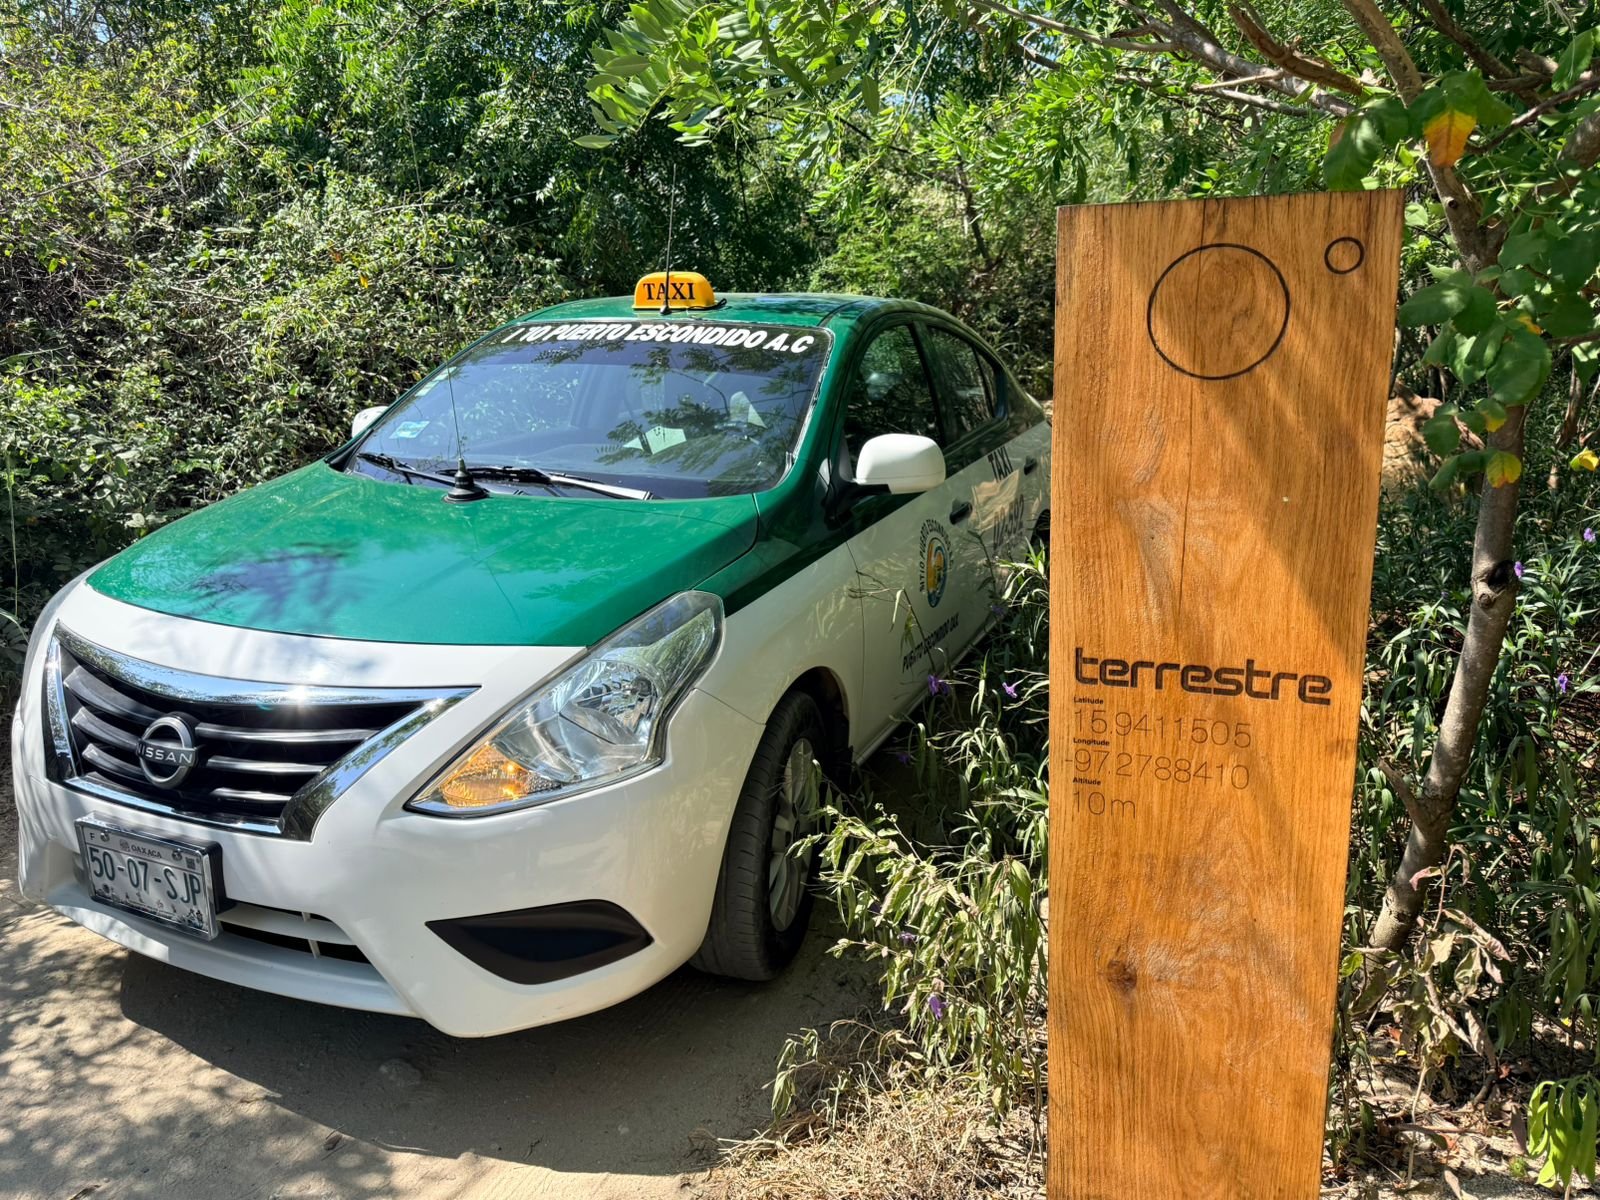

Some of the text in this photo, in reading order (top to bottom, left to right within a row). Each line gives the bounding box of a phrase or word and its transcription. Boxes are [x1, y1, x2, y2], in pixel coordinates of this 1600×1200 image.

[643, 282, 696, 301] TAXI
[541, 323, 632, 341] PUERTO
[623, 323, 768, 349] ESCONDIDO
[763, 333, 814, 354] A.C
[987, 446, 1013, 483] TAXI
[1075, 647, 1332, 706] terrestre
[1073, 695, 1104, 705] Latitude
[1074, 709, 1251, 748] 15.9411505
[136, 742, 193, 764] NISSAN
[1073, 737, 1110, 747] Longitude
[1065, 748, 1250, 790] -97.2788410
[1072, 776, 1101, 786] Altitude
[131, 844, 162, 858] OAXACA
[89, 847, 201, 906] 50-07-SJP
